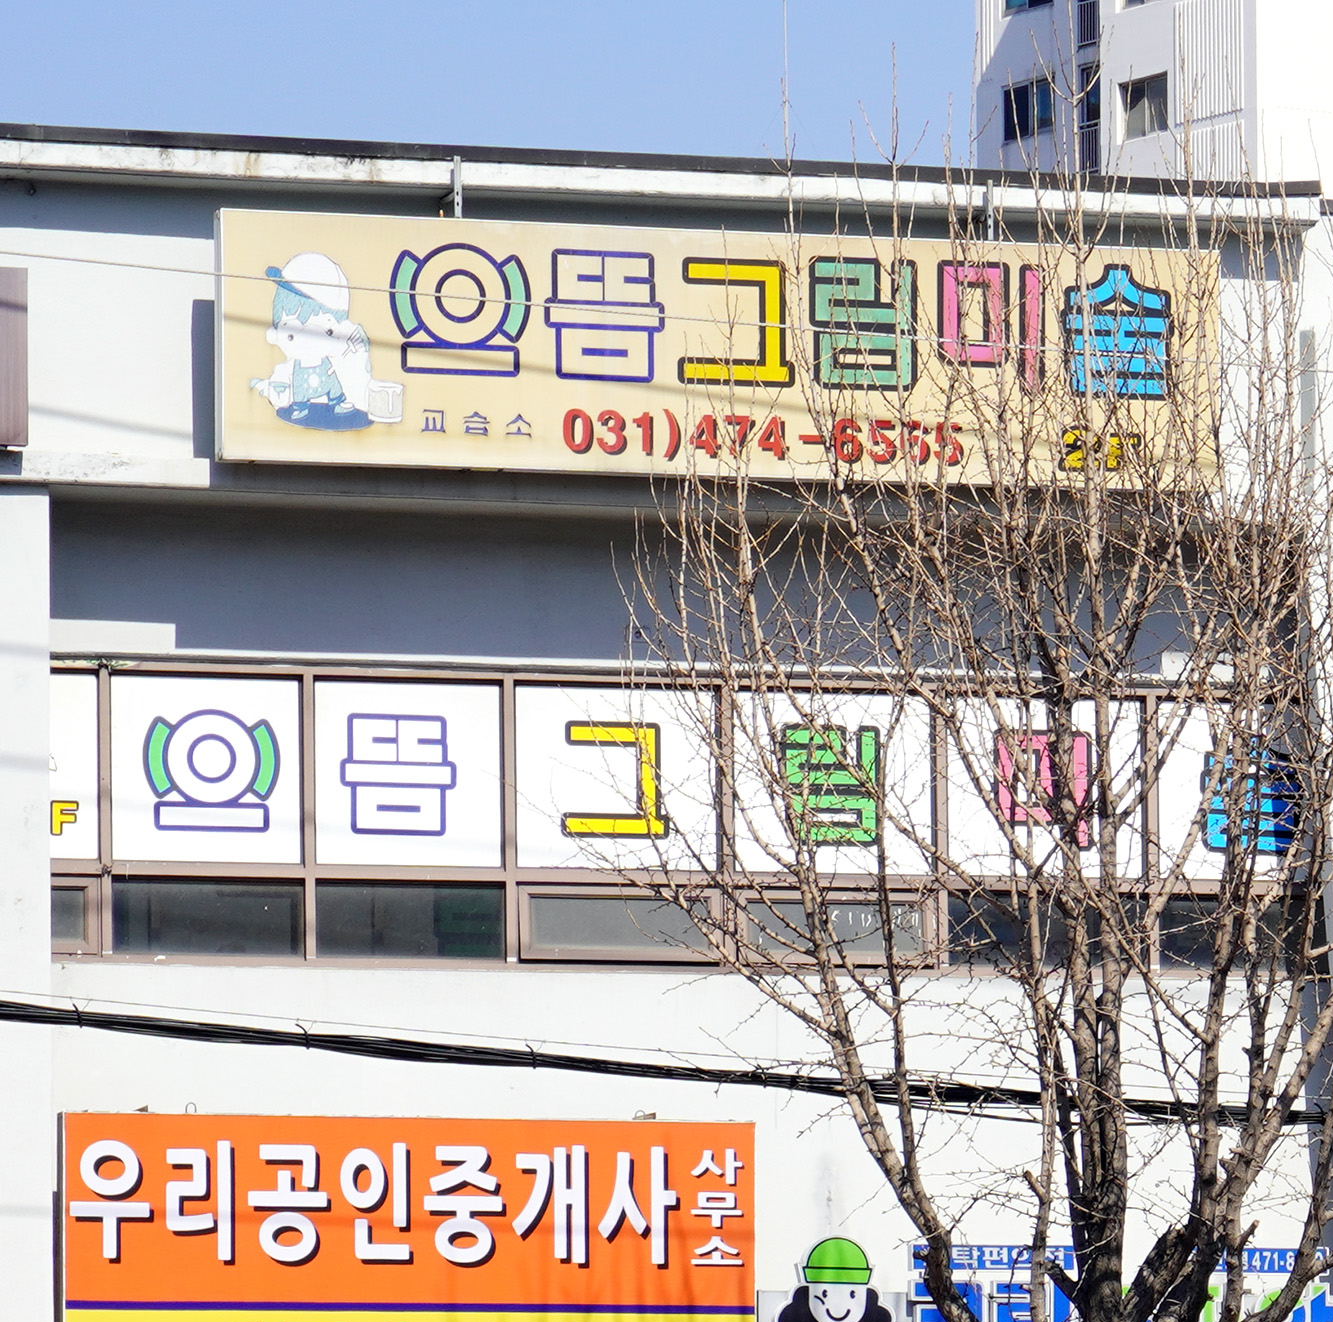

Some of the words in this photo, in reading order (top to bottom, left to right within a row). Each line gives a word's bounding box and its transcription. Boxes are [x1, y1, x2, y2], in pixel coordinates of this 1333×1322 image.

[420, 408, 532, 437] 교습소
[69, 1139, 678, 1267] 우리공인중개사
[690, 1149, 744, 1267] 사무소
